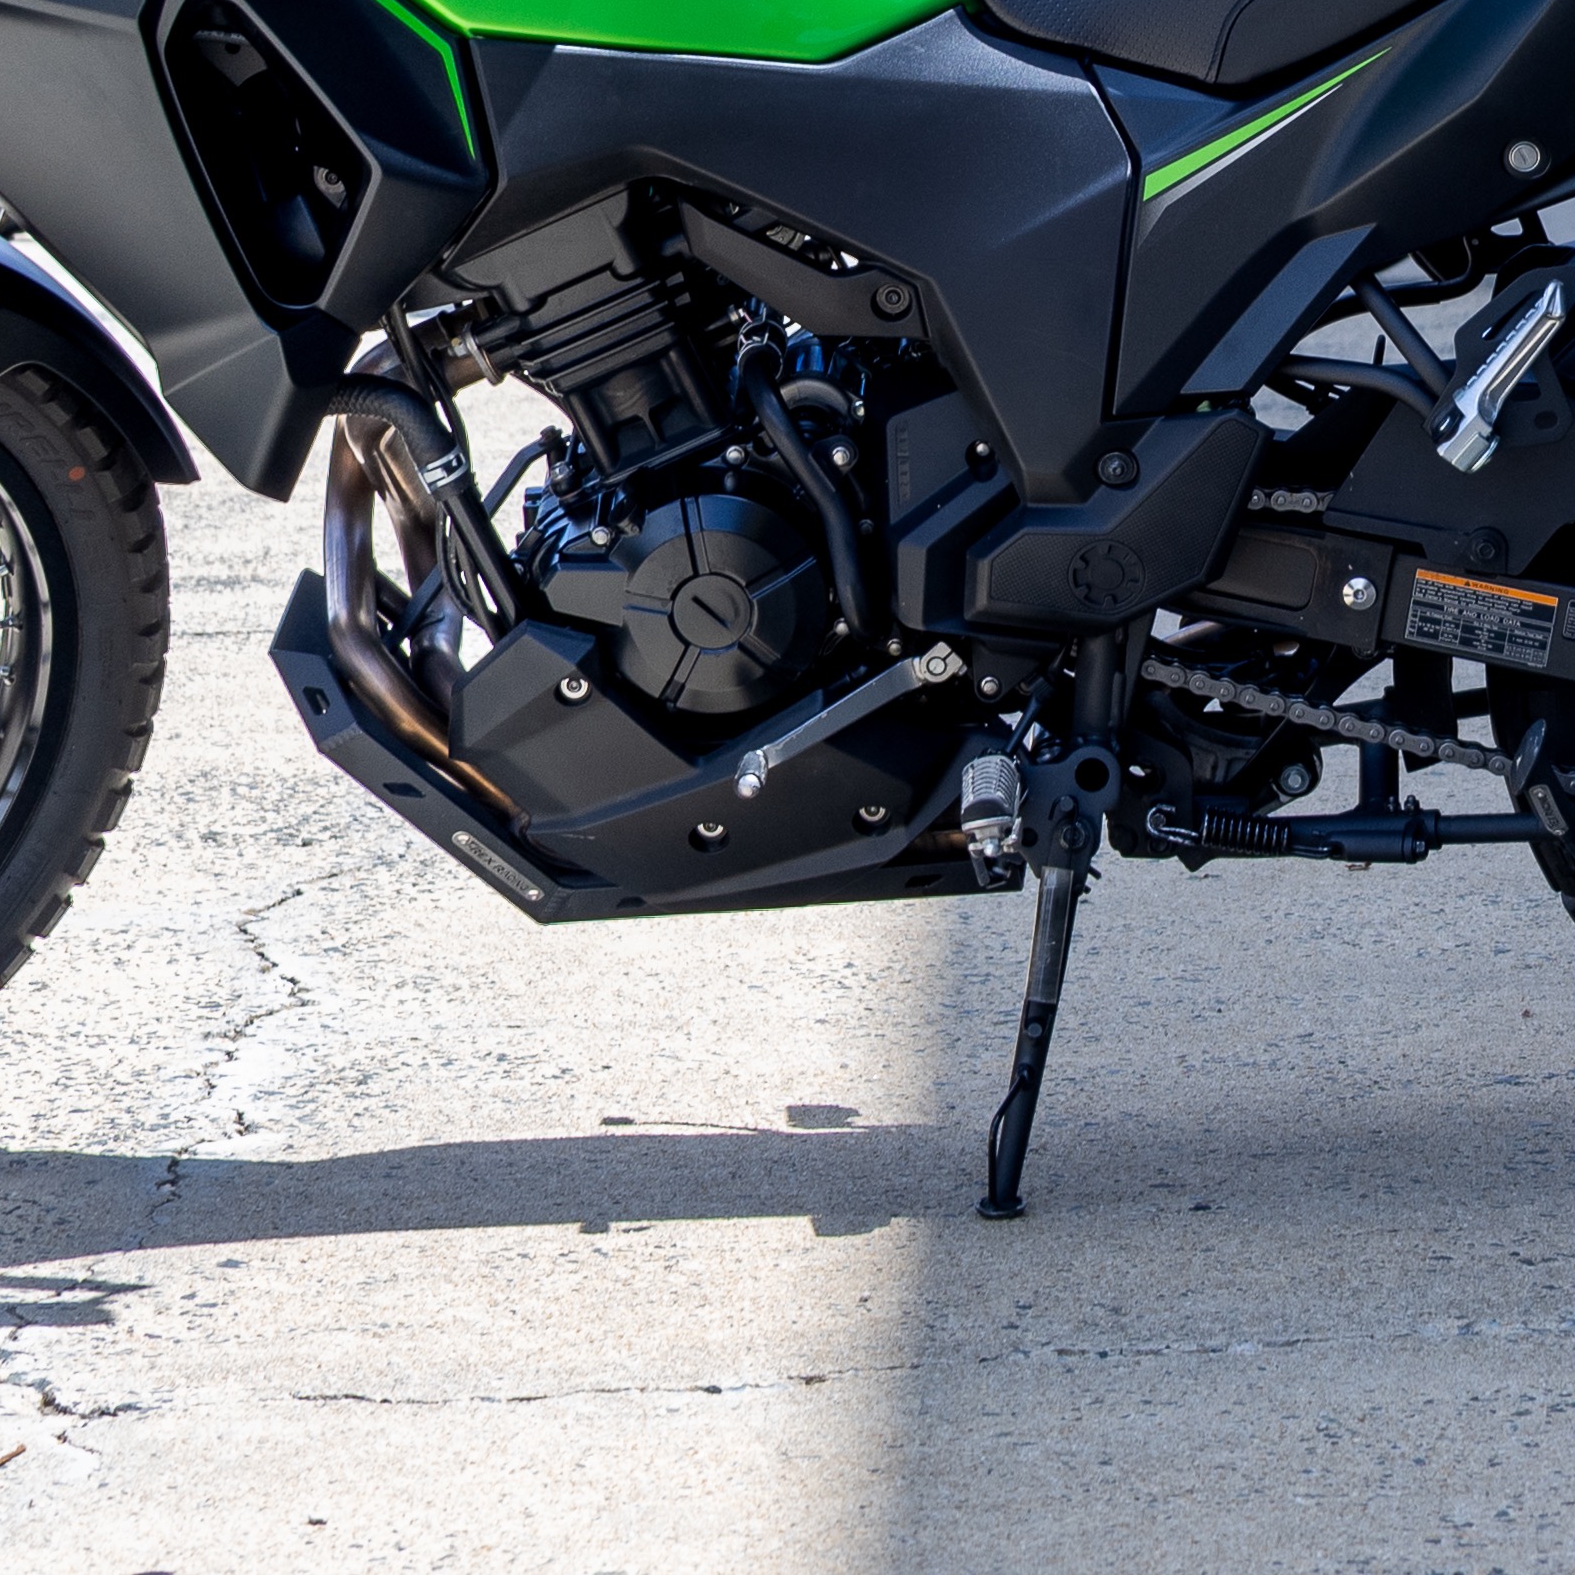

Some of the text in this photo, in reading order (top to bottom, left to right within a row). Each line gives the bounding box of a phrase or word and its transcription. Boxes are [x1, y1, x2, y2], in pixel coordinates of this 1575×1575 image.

[1471, 581, 1510, 595] WARNING
[1462, 610, 1477, 619] AND
[1480, 613, 1500, 624] LOAD
[1503, 617, 1521, 627] DATA
